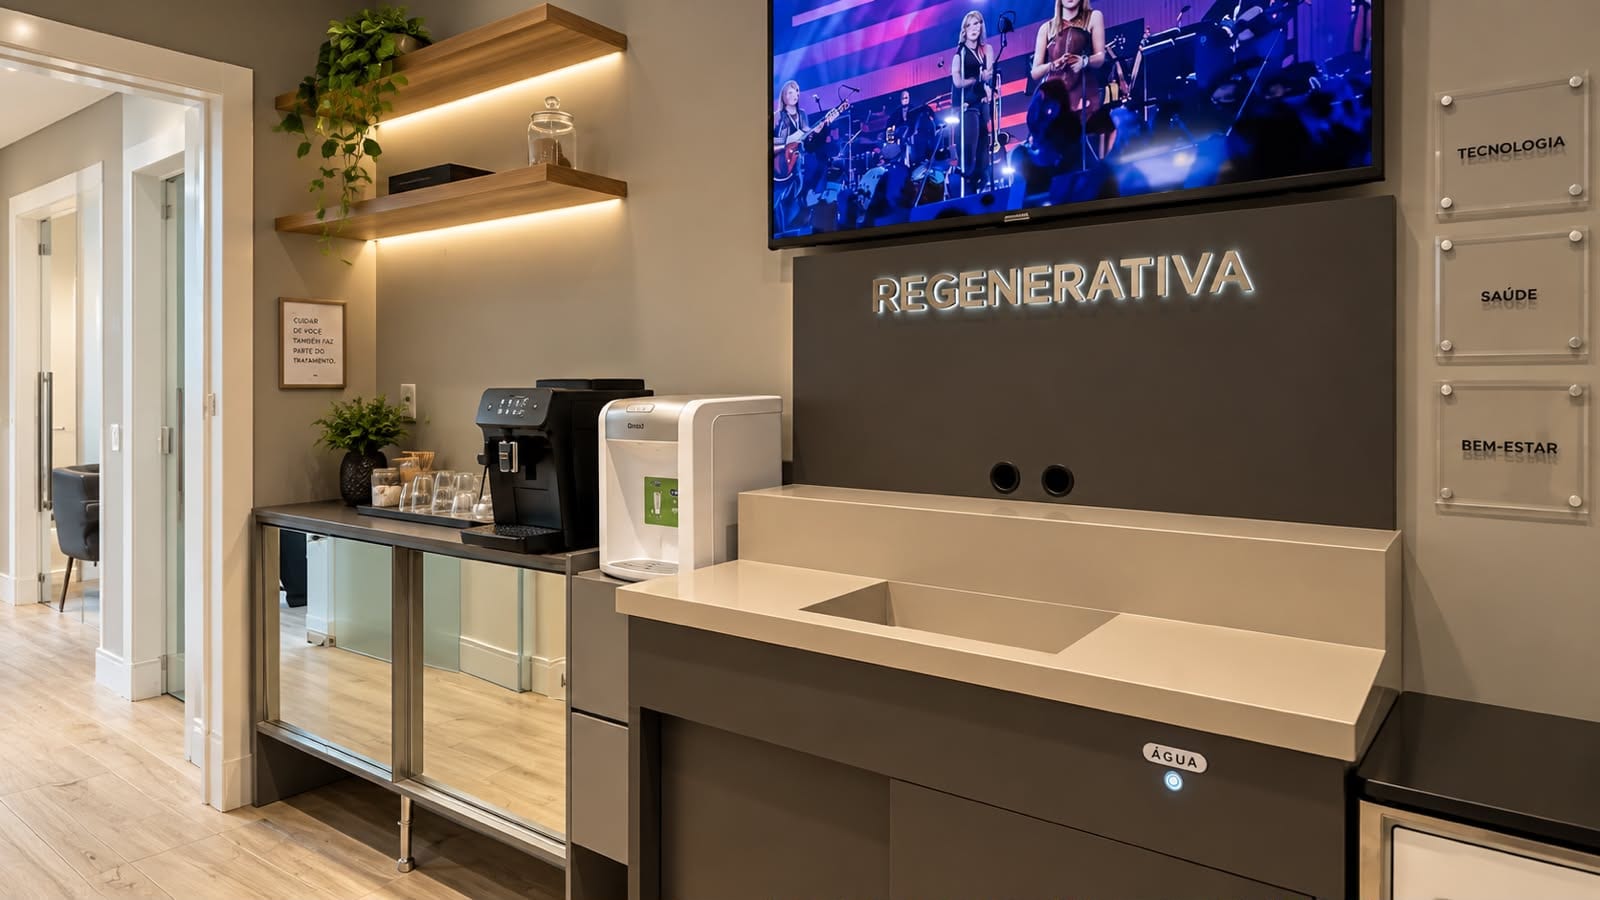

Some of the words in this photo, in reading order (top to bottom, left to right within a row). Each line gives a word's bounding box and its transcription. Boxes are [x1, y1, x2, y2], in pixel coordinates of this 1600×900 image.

[1457, 136, 1565, 159] TECNOLOGIA
[872, 250, 1253, 313] REGENERATIVA
[1481, 287, 1537, 302] SAÚDE
[1462, 440, 1557, 454] BEM-ESTAR
[1152, 746, 1197, 768] ÁGUA
